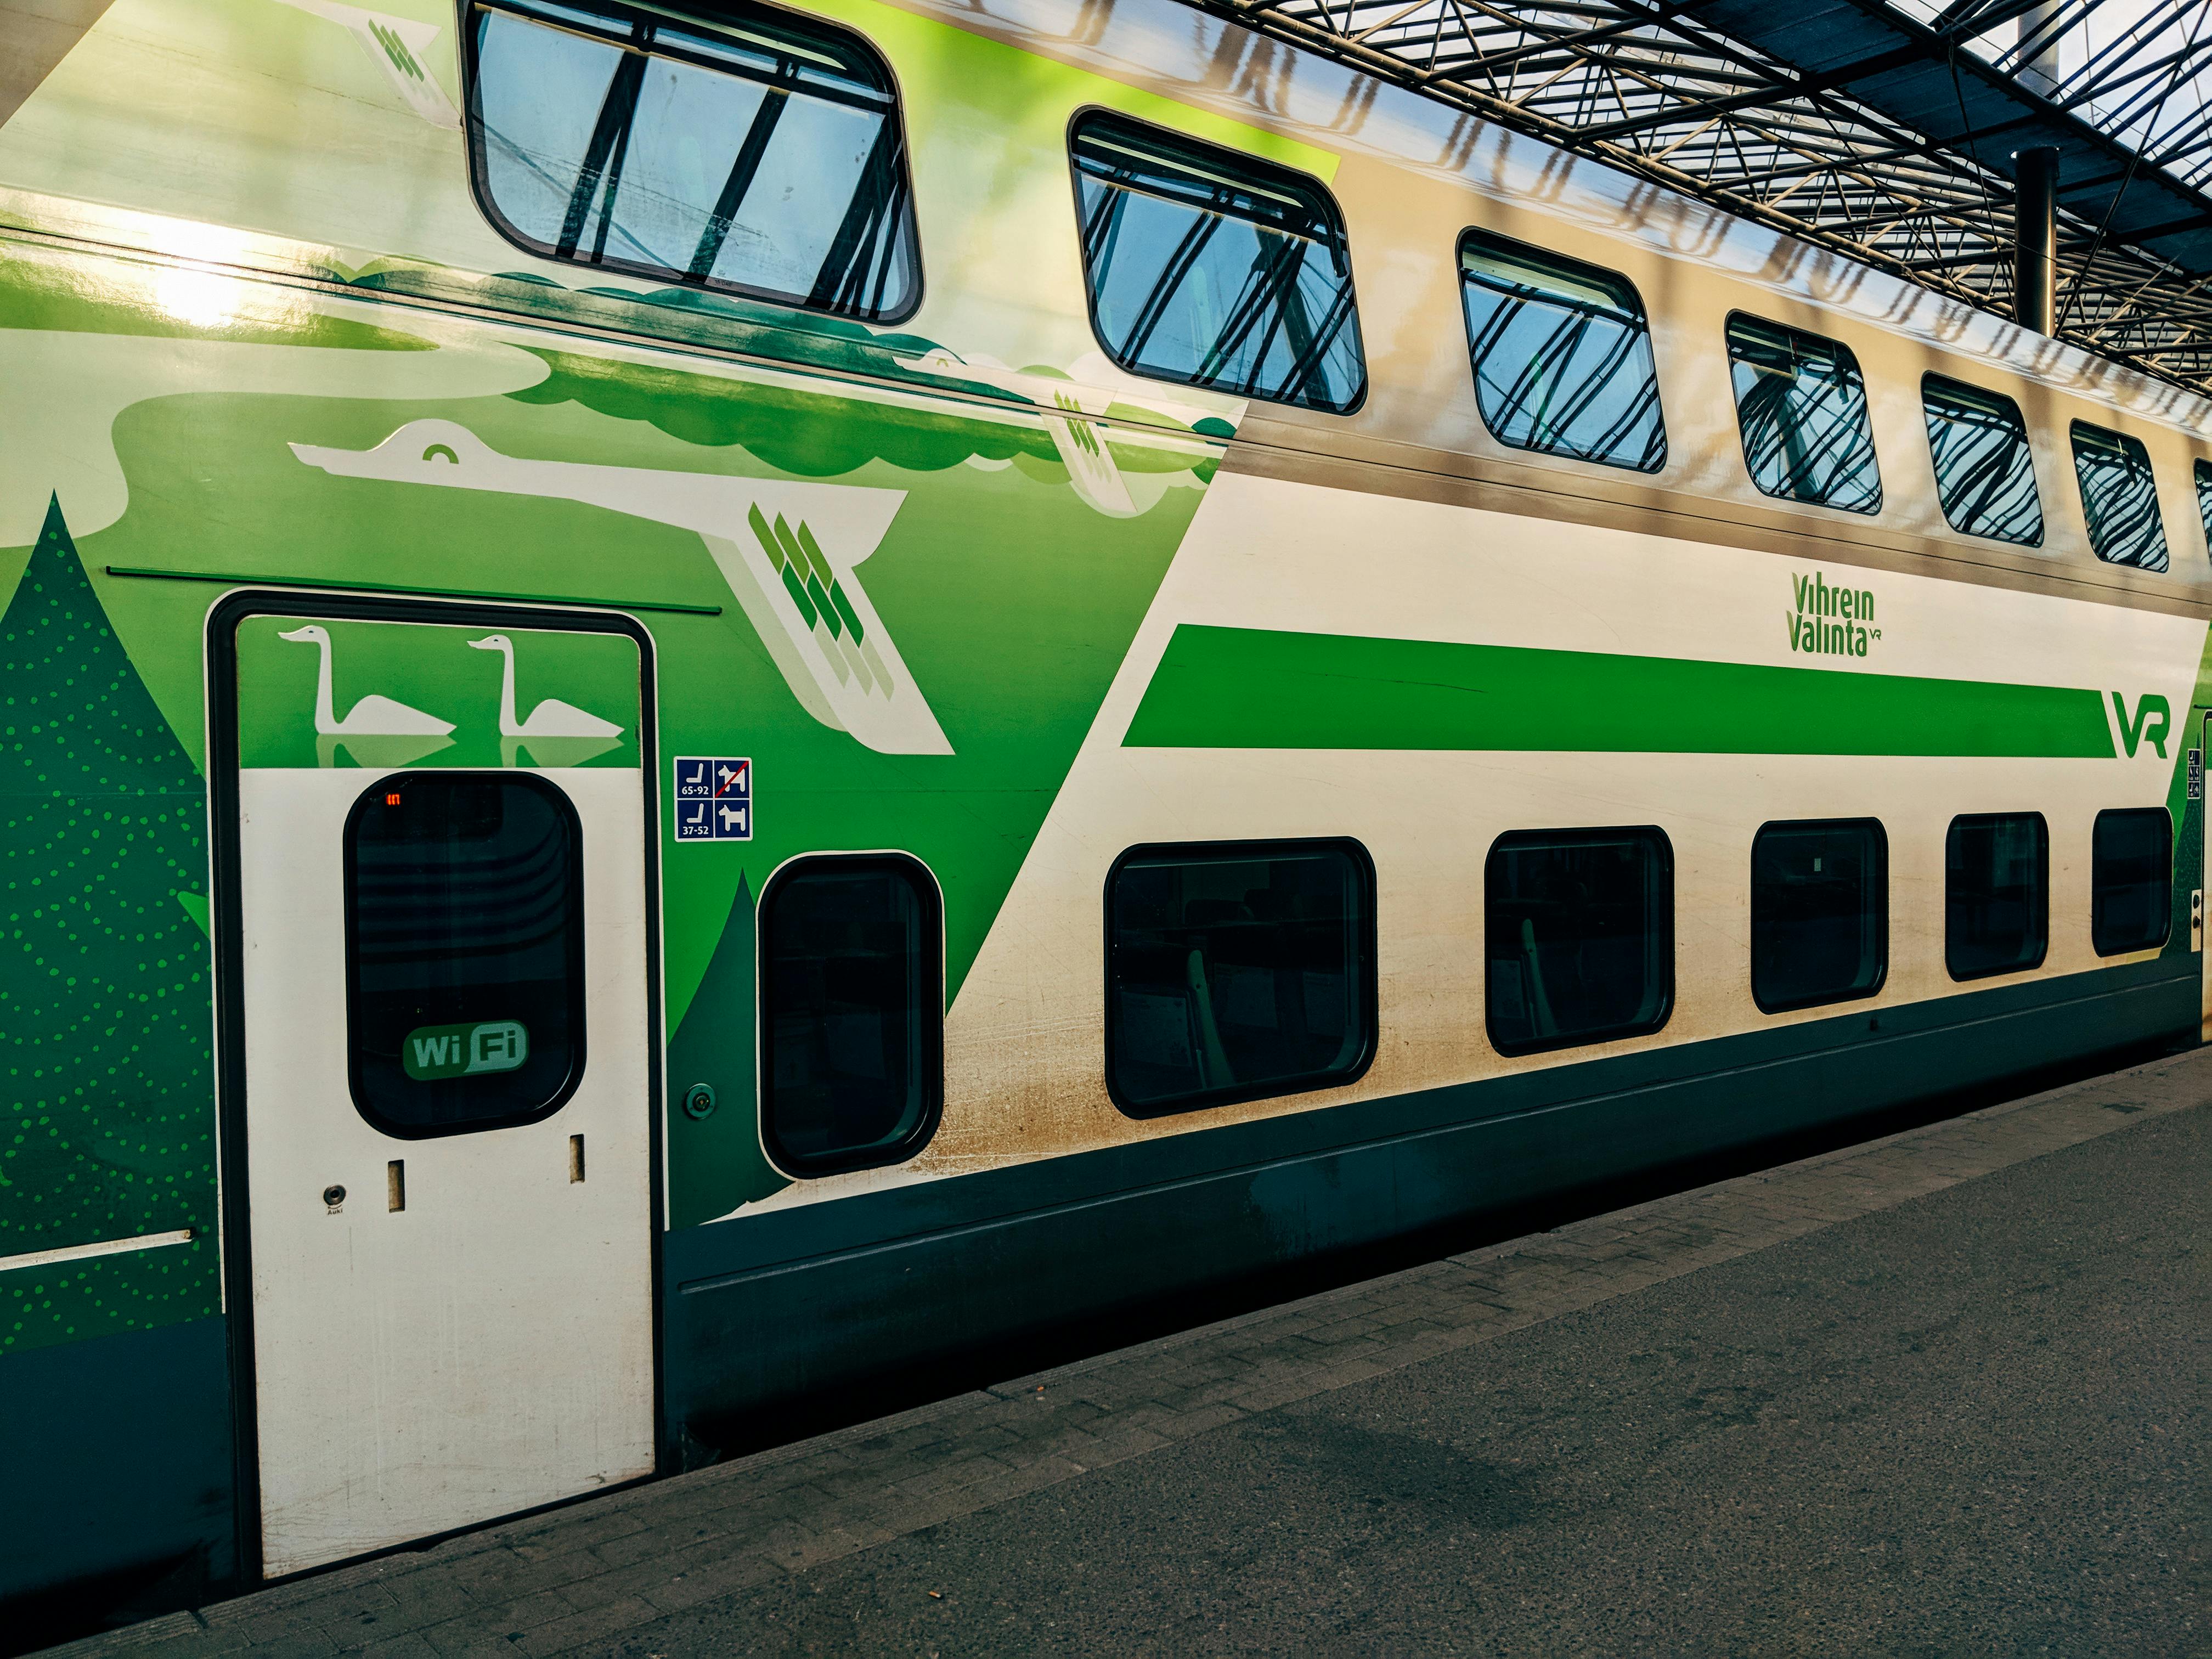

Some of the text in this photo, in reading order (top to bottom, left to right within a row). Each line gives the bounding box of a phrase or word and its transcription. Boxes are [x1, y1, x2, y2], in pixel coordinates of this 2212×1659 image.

[1792, 571, 1874, 621] Vihrein
[1786, 610, 1881, 657] Valinta VR
[2111, 691, 2171, 759] VR
[681, 786, 709, 795] 65-92
[682, 826, 709, 835] 37-52
